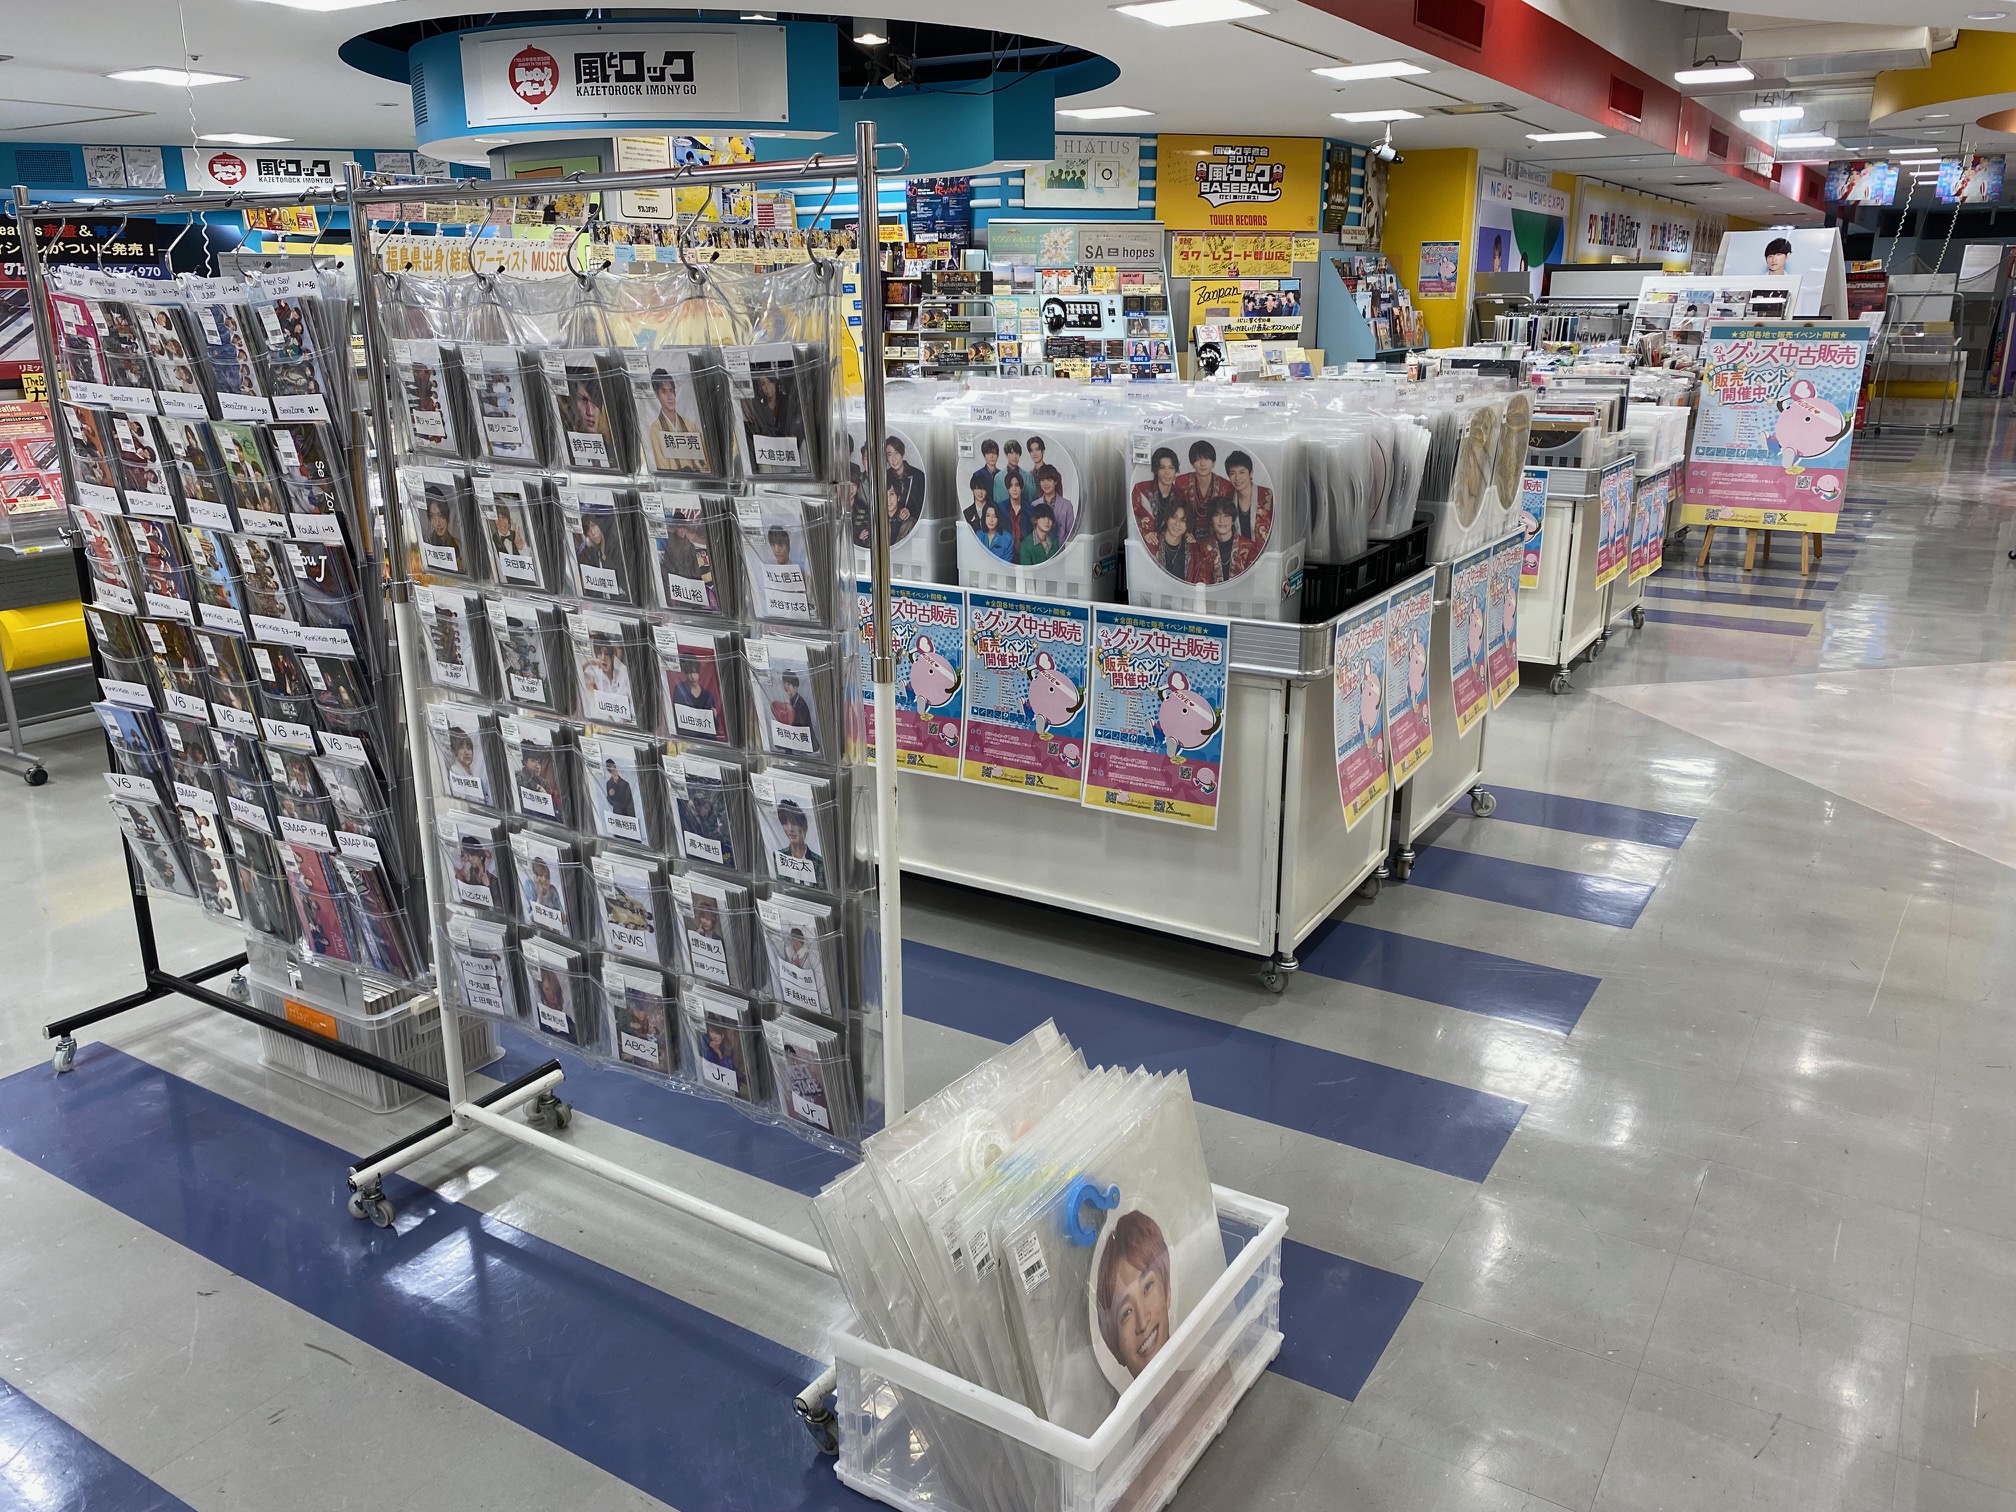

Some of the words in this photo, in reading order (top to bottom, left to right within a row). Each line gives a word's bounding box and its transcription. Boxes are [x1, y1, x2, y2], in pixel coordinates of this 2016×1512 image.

[574, 51, 697, 83] 風とロック
[576, 85, 643, 97] KAZETOROCK
[646, 84, 681, 96] IMONY
[684, 84, 697, 95] GO
[256, 159, 331, 177] 風とロック
[1229, 156, 1255, 164] 2014
[258, 176, 301, 184] KAZETOROCK
[302, 176, 323, 184] IMONY
[324, 176, 334, 184] GO
[1208, 164, 1272, 182] 風とロック
[1200, 182, 1277, 193] BASEBALL
[1490, 180, 1512, 200] NEWS
[1209, 214, 1233, 226] TOWER
[1236, 214, 1267, 226] RECORDS
[1085, 245, 1104, 259] SA
[1122, 247, 1155, 260] hopes
[531, 250, 568, 272] MUSIC
[1739, 331, 1841, 340] 全国各地で販売イベント開催
[1726, 342, 1858, 370] グッズ中古販売
[1714, 370, 1789, 388] 販売イベント
[1722, 384, 1777, 406] 開催中!!
[572, 438, 605, 455] 錦戸亮
[663, 433, 701, 451] 錦戸亮
[758, 447, 797, 465] 大倉忠義
[504, 557, 534, 572] 安田章大
[585, 574, 614, 590] 丸山隆平
[670, 583, 704, 603] 横山裕
[990, 601, 1067, 617] 全国各地で販売イベント開催
[983, 610, 1082, 647] グッズ中古販売
[1120, 617, 1204, 637] 全国各地で販売イベント開催
[978, 638, 1037, 658] 販売イベント
[1112, 628, 1220, 662] グッズ中古販売
[985, 653, 1029, 672] 開催中!!
[1104, 655, 1165, 677] 販売イベント
[445, 671, 462, 679] JUMP
[1112, 672, 1158, 691] 開催中!!
[520, 685, 538, 694] JUMP
[1176, 691, 1191, 704] LOVE
[170, 692, 187, 708] V6
[598, 701, 628, 715] 山田涼介
[219, 708, 235, 724] V6
[679, 714, 712, 730] 山田涼介
[268, 722, 288, 738] V6
[775, 726, 810, 742] 有岡大貴
[324, 734, 342, 751] V6
[112, 773, 131, 789] V6
[177, 786, 197, 799] SMAP
[230, 800, 249, 814] SMAP
[282, 821, 308, 833] SMAP
[607, 815, 638, 832] 中島裕翔
[338, 836, 361, 848] SMAP
[688, 838, 720, 855] 高木雄也
[535, 906, 562, 923] 岡本圭人
[611, 929, 644, 948] NEWS
[691, 937, 722, 955] 増田貴久
[468, 978, 498, 992] 中丸雄一
[784, 987, 818, 1008] 手越祐也
[624, 1039, 658, 1058] ABC-Z
[712, 1068, 730, 1086] Jr.
[791, 1081, 823, 1100] STAGE
[802, 1104, 821, 1122] Jr.
